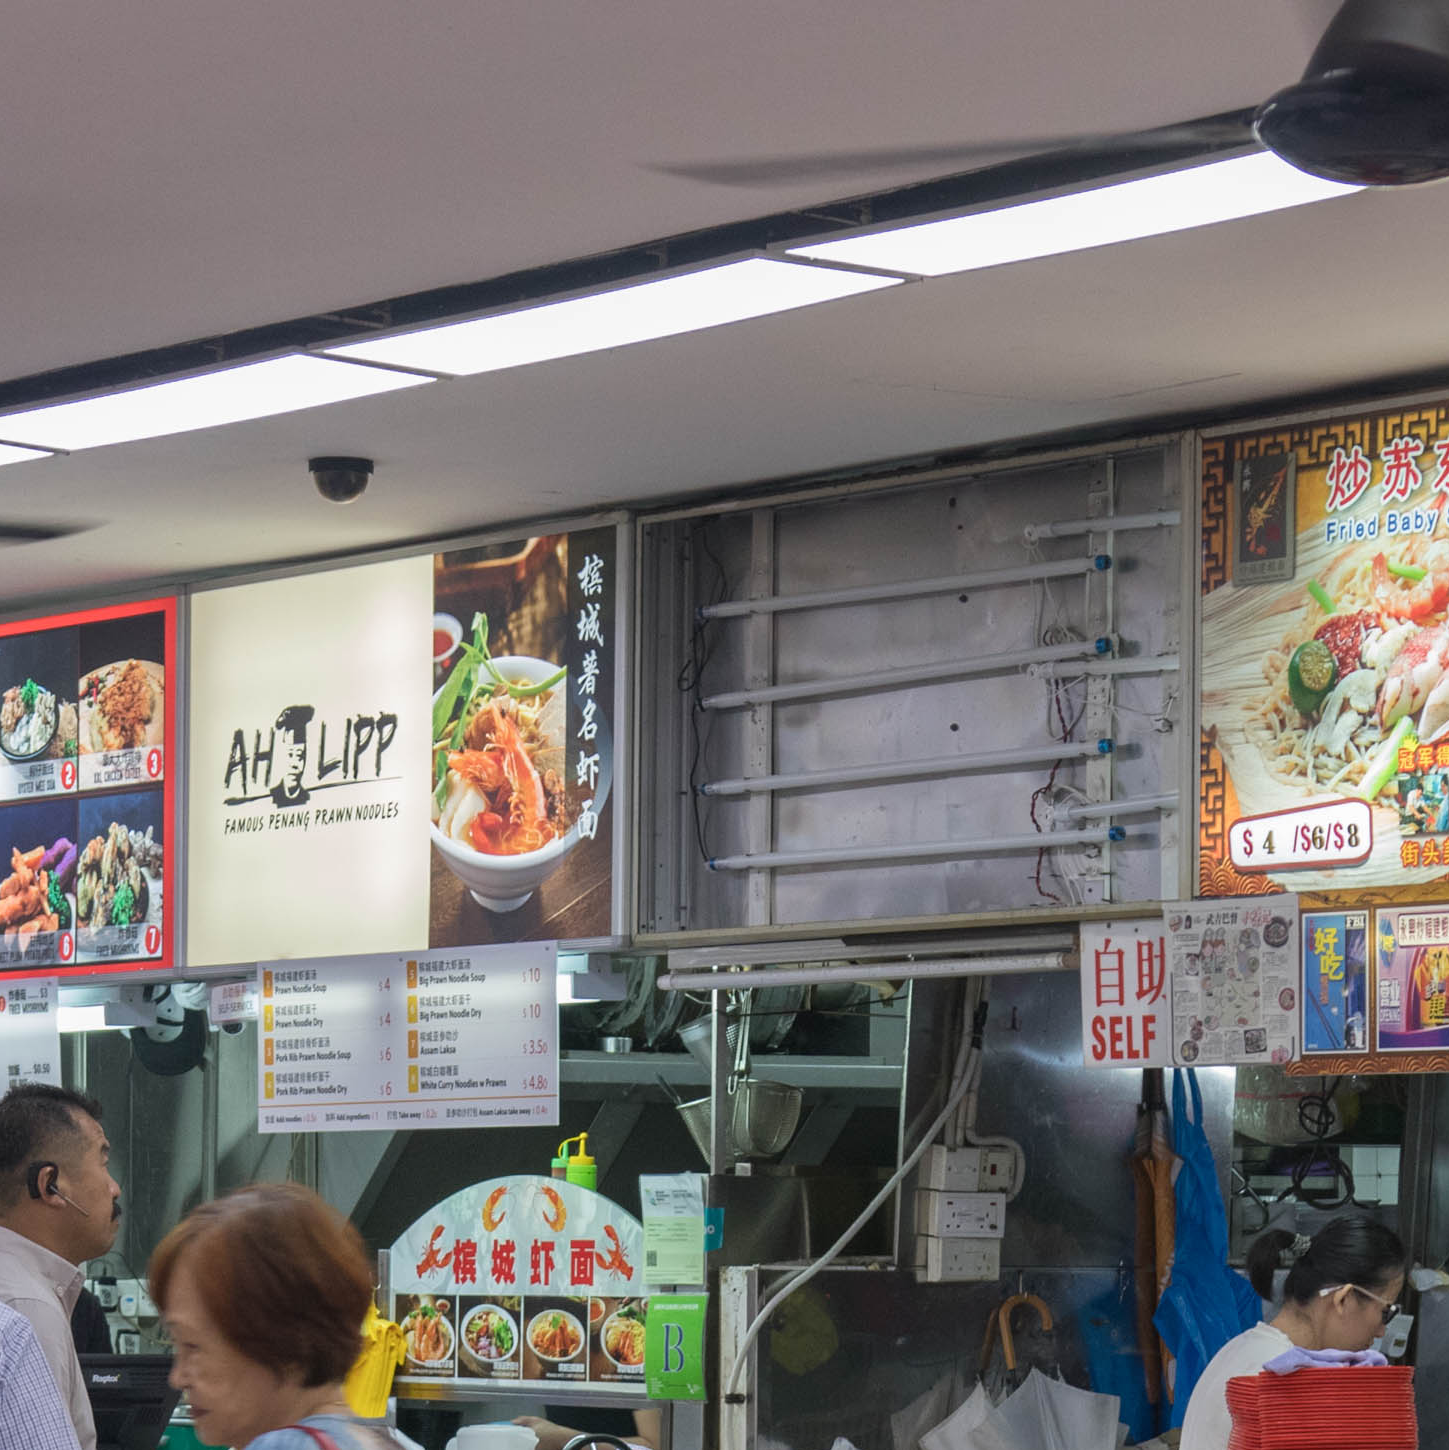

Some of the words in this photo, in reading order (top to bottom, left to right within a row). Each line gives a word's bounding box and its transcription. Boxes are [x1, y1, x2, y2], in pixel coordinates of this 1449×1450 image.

[1326, 516, 1377, 543] Fried
[1386, 507, 1439, 535] Baby
[224, 727, 275, 795] AH
[317, 710, 399, 781] LIPP
[65, 767, 73, 785] 2
[150, 753, 158, 773] 3
[224, 814, 265, 835] FAMOUS
[268, 809, 311, 833] PENANG
[314, 805, 353, 826] PRAWN
[354, 802, 399, 822] NOODLES
[62, 937, 70, 956] 6
[149, 929, 157, 948] 7
[1314, 928, 1344, 981] 好吃
[275, 985, 292, 995] Prawn
[294, 985, 312, 993] Noodle
[312, 984, 327, 993] Soup
[419, 976, 429, 987] Big
[430, 975, 447, 984] Prawn
[449, 974, 469, 983] Noodle
[471, 972, 486, 982] Soup
[275, 1019, 292, 1028] Prawn
[293, 1019, 312, 1027] Noodle
[313, 1018, 323, 1028] Dry
[420, 1012, 429, 1022] Big
[430, 1011, 448, 1020] Prawn
[449, 1009, 470, 1018] Noodle
[471, 1008, 481, 1019] Dry
[420, 1046, 439, 1055] Assam
[439, 1045, 456, 1054] Laksa
[1091, 1015, 1156, 1060] SELF
[276, 1054, 287, 1062] Pork
[289, 1053, 298, 1061] Rib
[300, 1053, 315, 1061] Prawn
[316, 1052, 336, 1060] Noodle
[337, 1051, 351, 1061] Soup
[276, 1088, 288, 1096] Pork
[289, 1087, 298, 1095] Rib
[317, 1086, 335, 1094] Noodle
[337, 1085, 347, 1096] Dry
[421, 1081, 437, 1090] White
[438, 1080, 454, 1090] Curry
[455, 1079, 478, 1088] Noodles
[486, 1078, 506, 1087] Prawns
[452, 1238, 596, 1286] 槟城虾面
[661, 1322, 685, 1373] B
